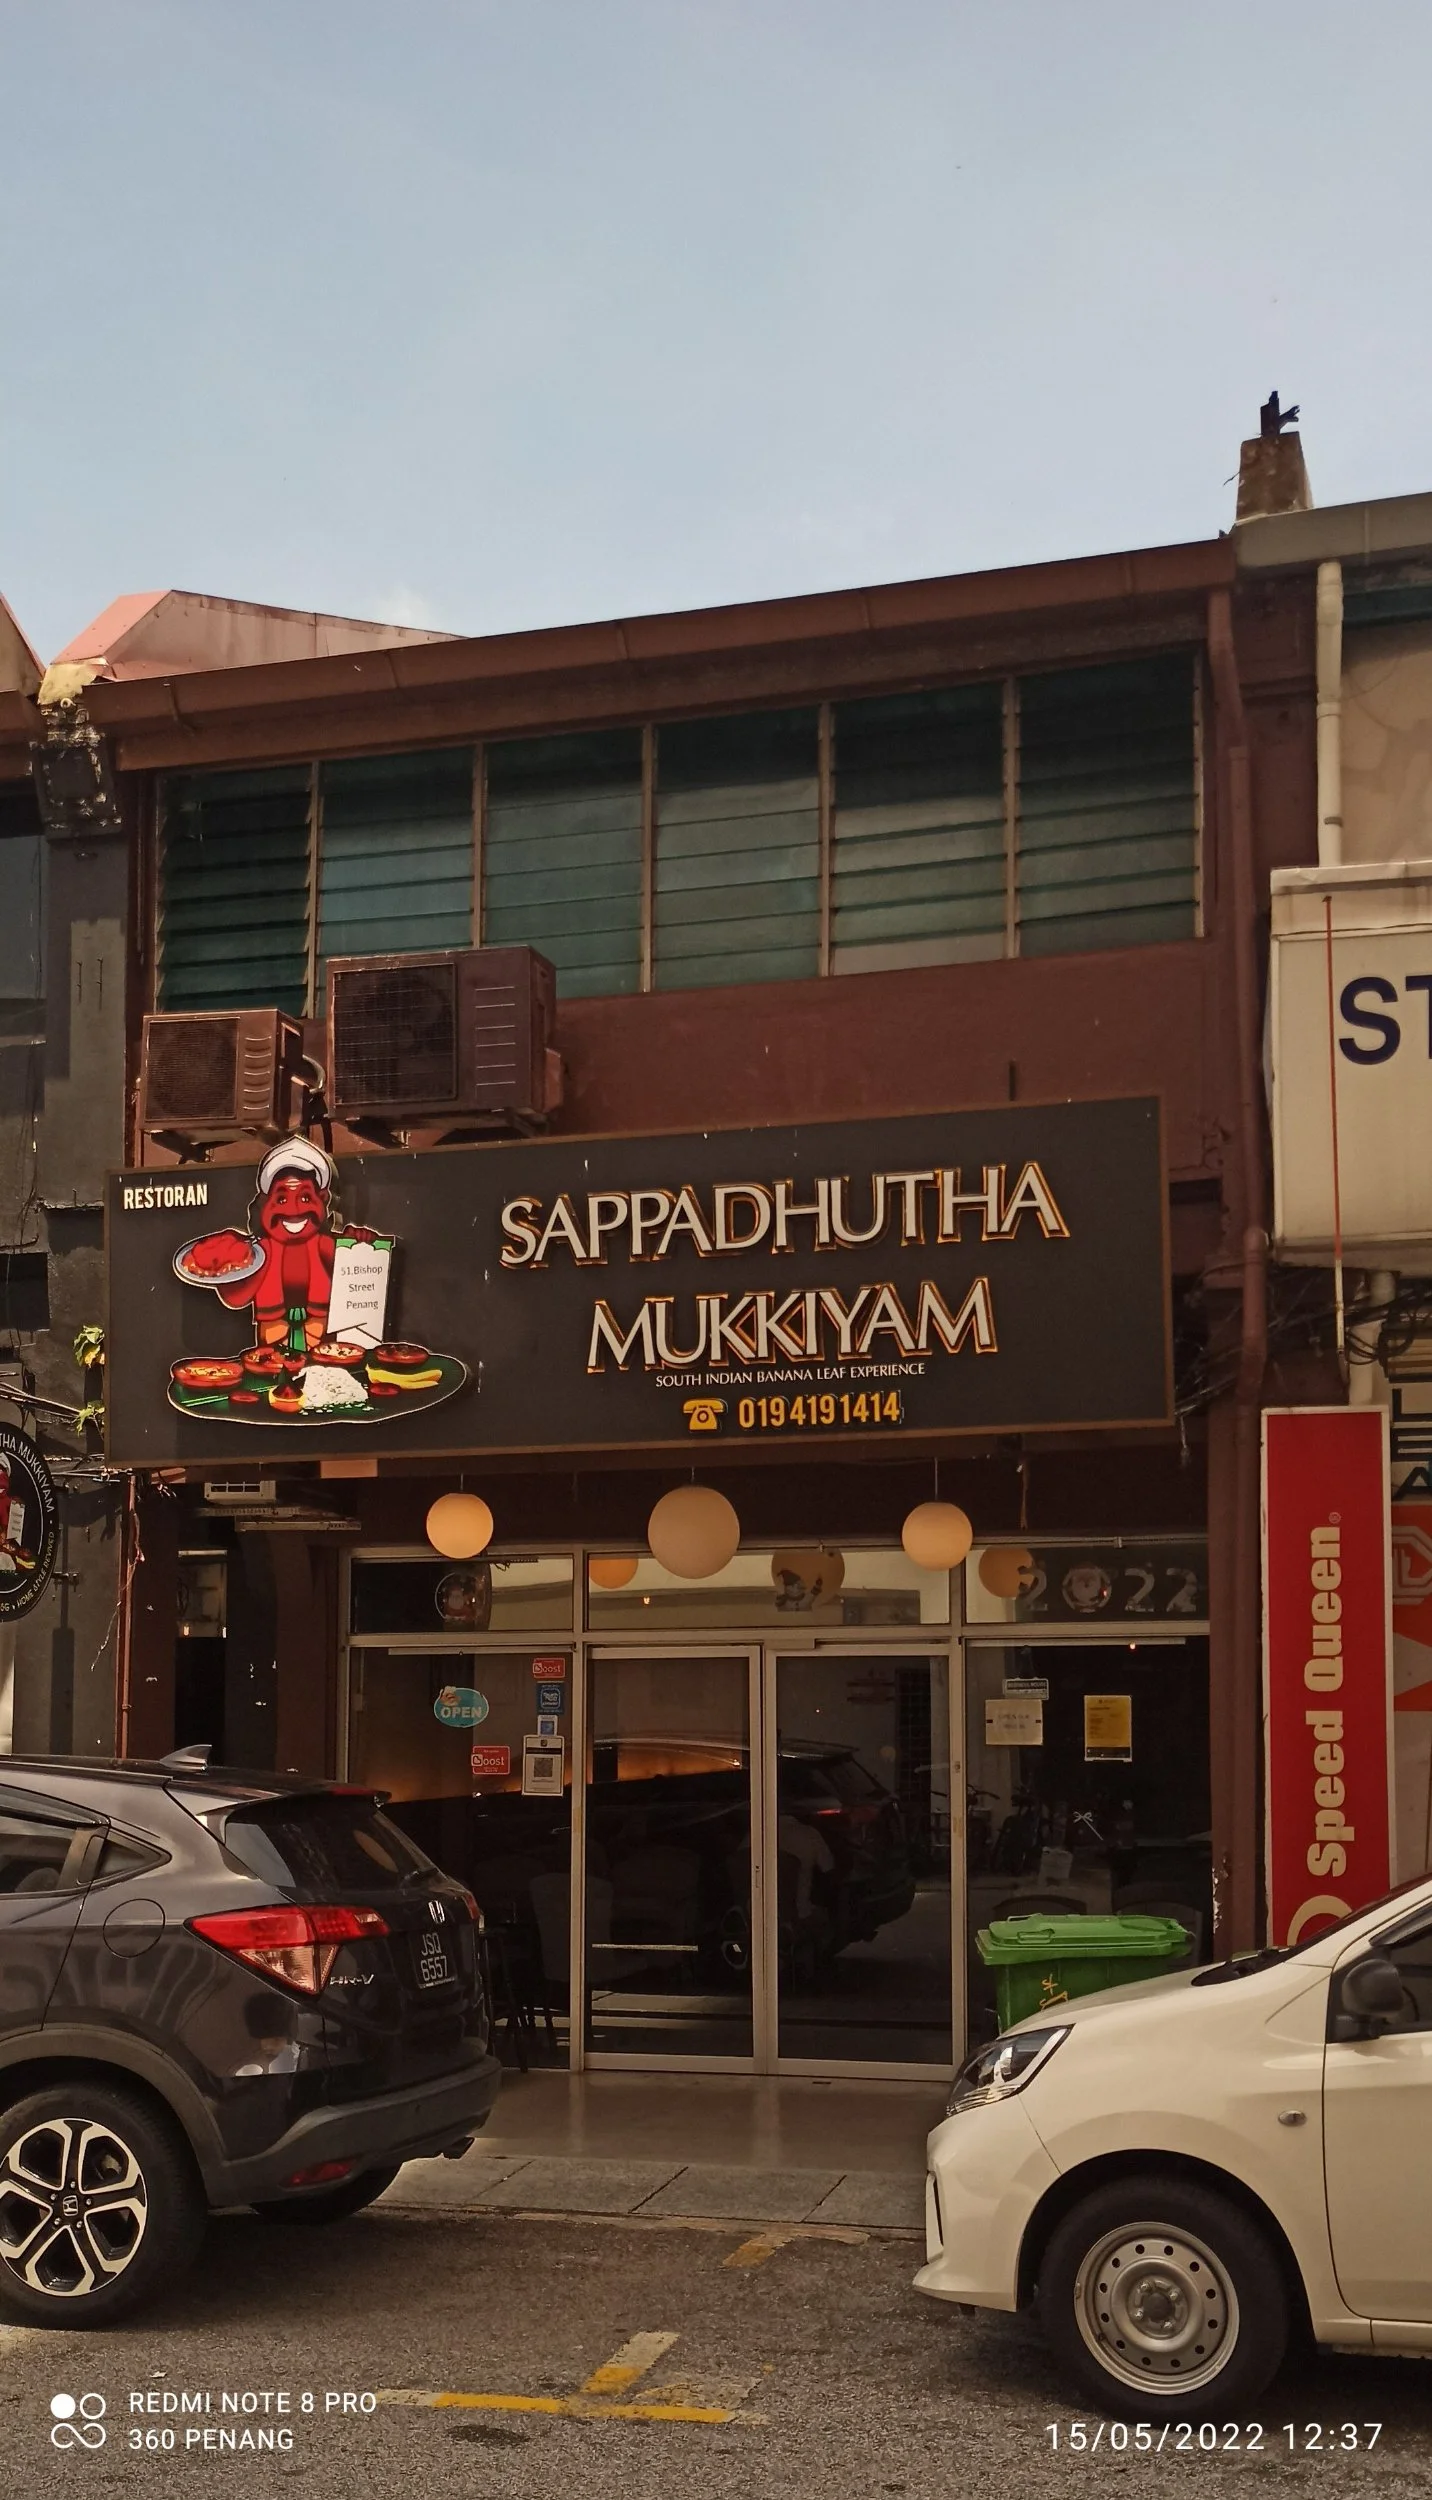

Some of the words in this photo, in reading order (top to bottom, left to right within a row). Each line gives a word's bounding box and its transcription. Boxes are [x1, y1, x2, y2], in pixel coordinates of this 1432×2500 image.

[123, 1183, 208, 1210] RESTORAN
[500, 1160, 1071, 1268] SAPPADHUTHA
[348, 1283, 375, 1293] Street
[346, 1300, 379, 1310] Penang
[587, 1276, 998, 1374] MUKKIYAM
[655, 1374, 701, 1388] SOUTH
[706, 1371, 752, 1385] INDIAN
[757, 1369, 813, 1383] BANANA
[817, 1367, 847, 1380] LEAF
[850, 1362, 926, 1378] EXPERIENCE
[17, 1440, 55, 1513] MUKKIYAM
[1303, 1526, 1344, 1692] Queen
[440, 1706, 482, 1719] OPEN
[1305, 1710, 1355, 1877] Speed
[421, 1932, 442, 1957] JSQ
[420, 1955, 448, 1982] 6557
